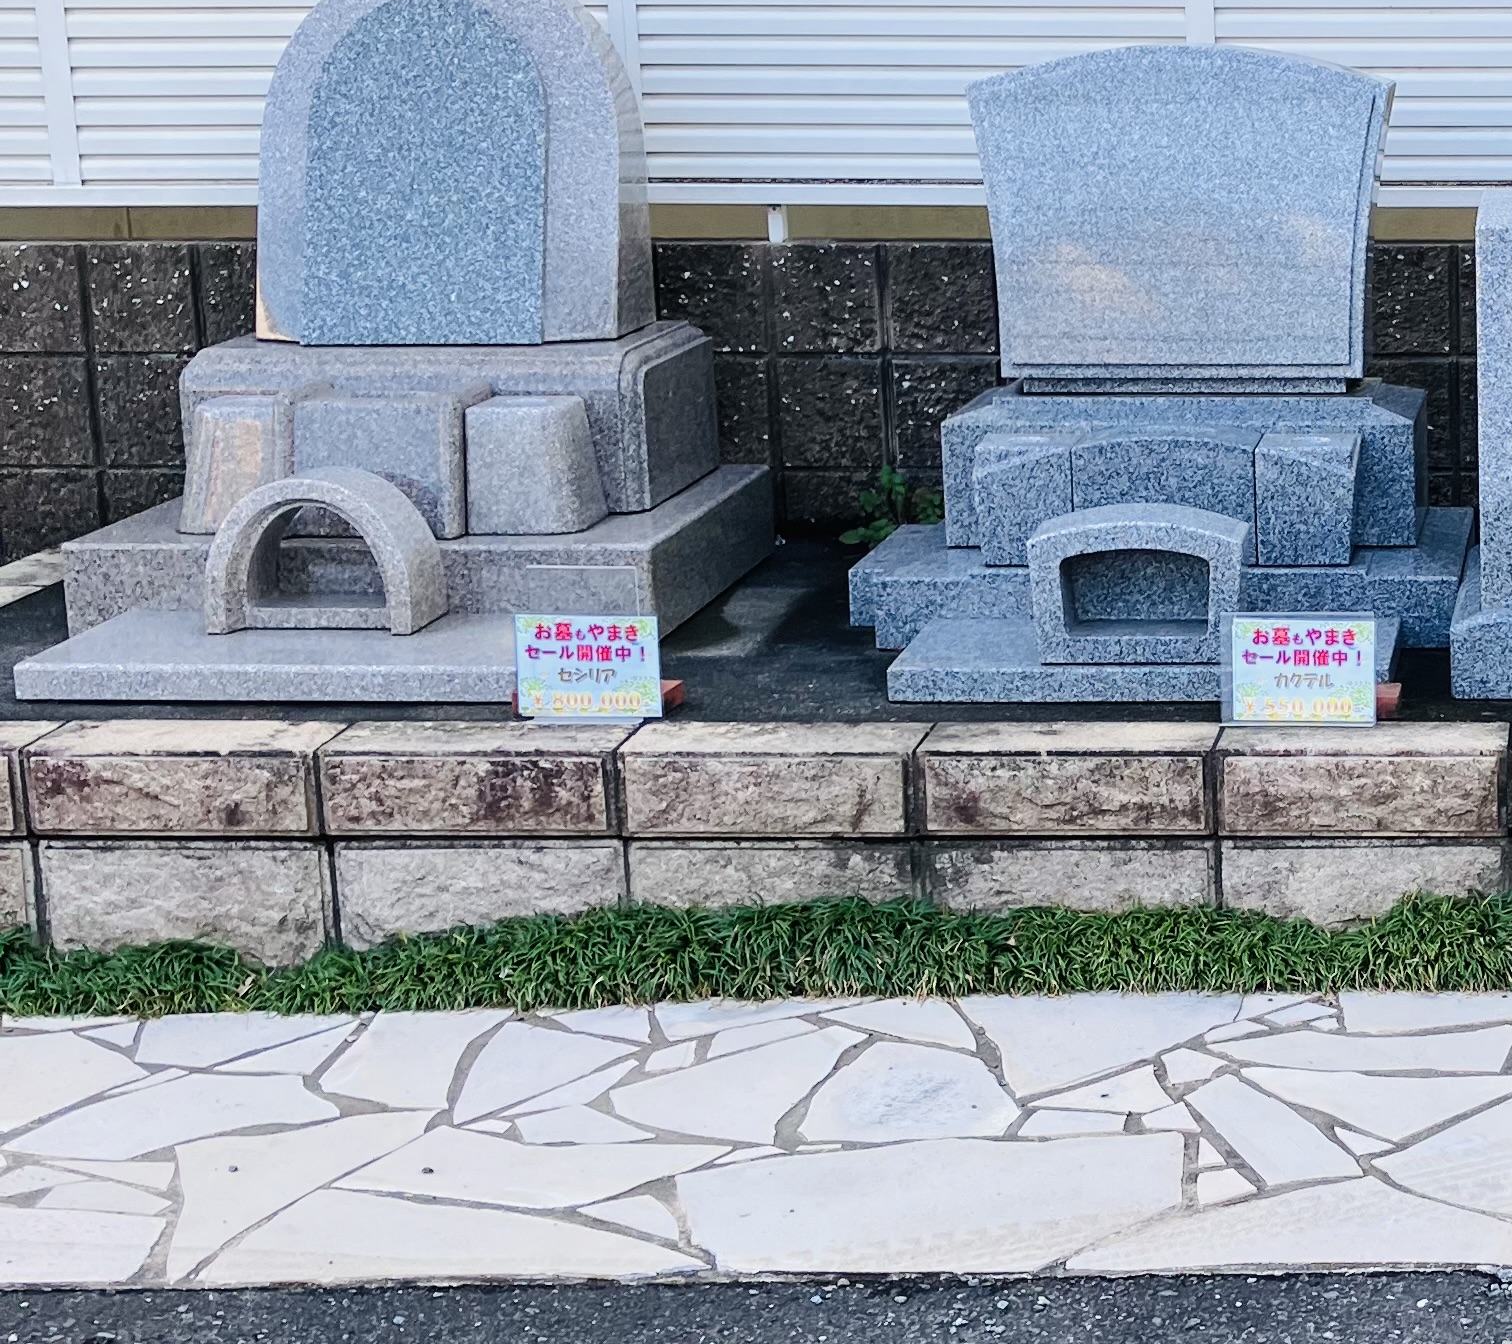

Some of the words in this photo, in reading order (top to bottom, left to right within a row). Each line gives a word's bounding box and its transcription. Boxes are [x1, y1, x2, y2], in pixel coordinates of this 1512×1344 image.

[558, 667, 617, 684] セシリア
[1274, 673, 1334, 690] カクテル
